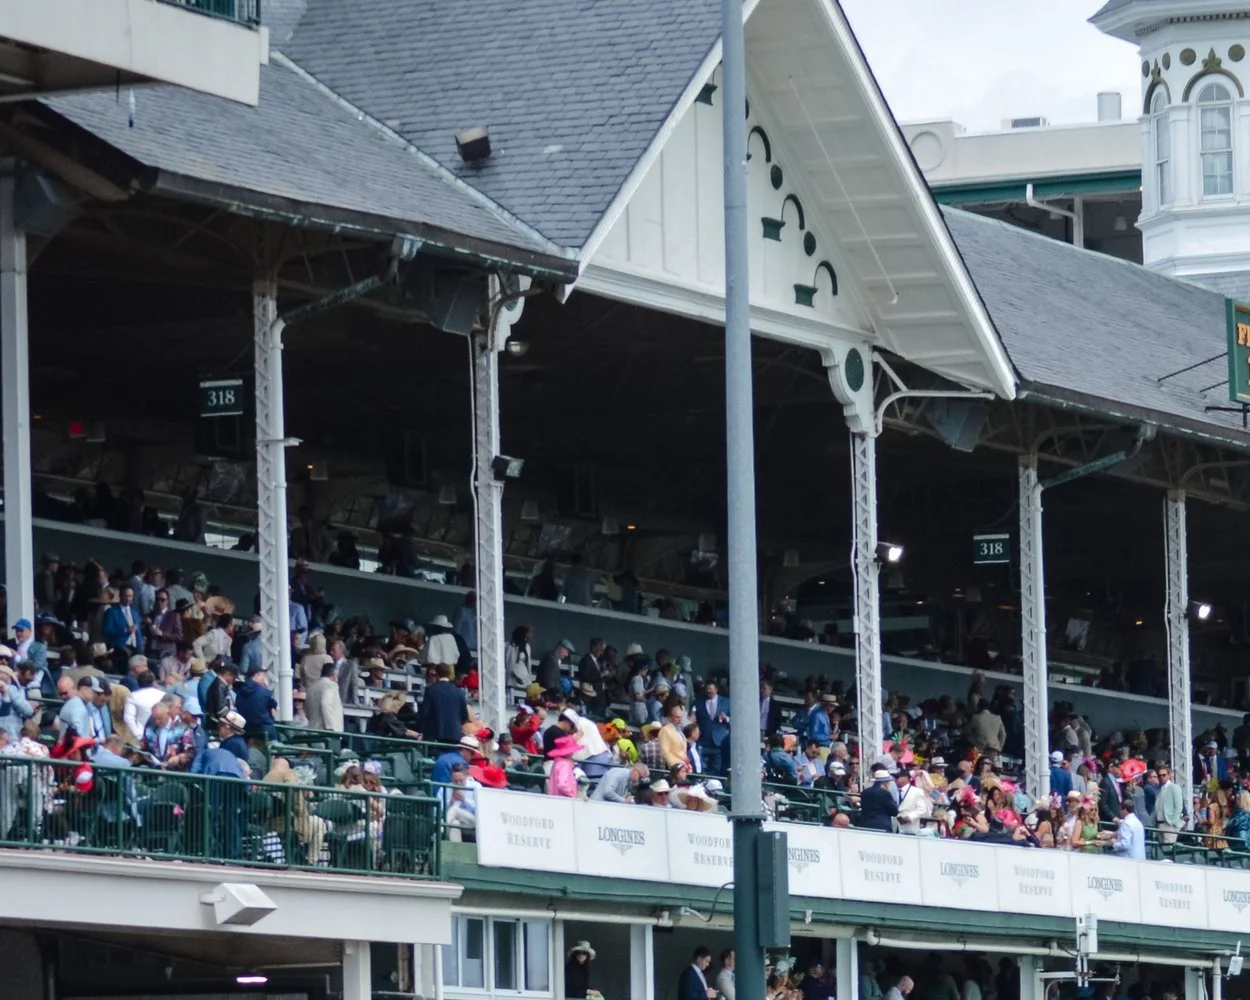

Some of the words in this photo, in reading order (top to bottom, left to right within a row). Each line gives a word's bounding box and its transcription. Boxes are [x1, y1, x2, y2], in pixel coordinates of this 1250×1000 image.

[207, 390, 235, 406] 318
[980, 542, 1003, 555] 318
[501, 812, 554, 830] WOODFORD
[507, 833, 552, 849] RESERVE
[598, 827, 645, 845] LONGINES
[688, 833, 732, 849] WOODFOR
[694, 852, 734, 867] RESERVE
[788, 847, 820, 863] NGINES
[858, 850, 903, 866] WOODFORD
[864, 871, 901, 884] RESERVE
[940, 862, 979, 878] LONGINES
[1014, 865, 1055, 880] WOODFORD
[1088, 876, 1123, 892] LONGINES
